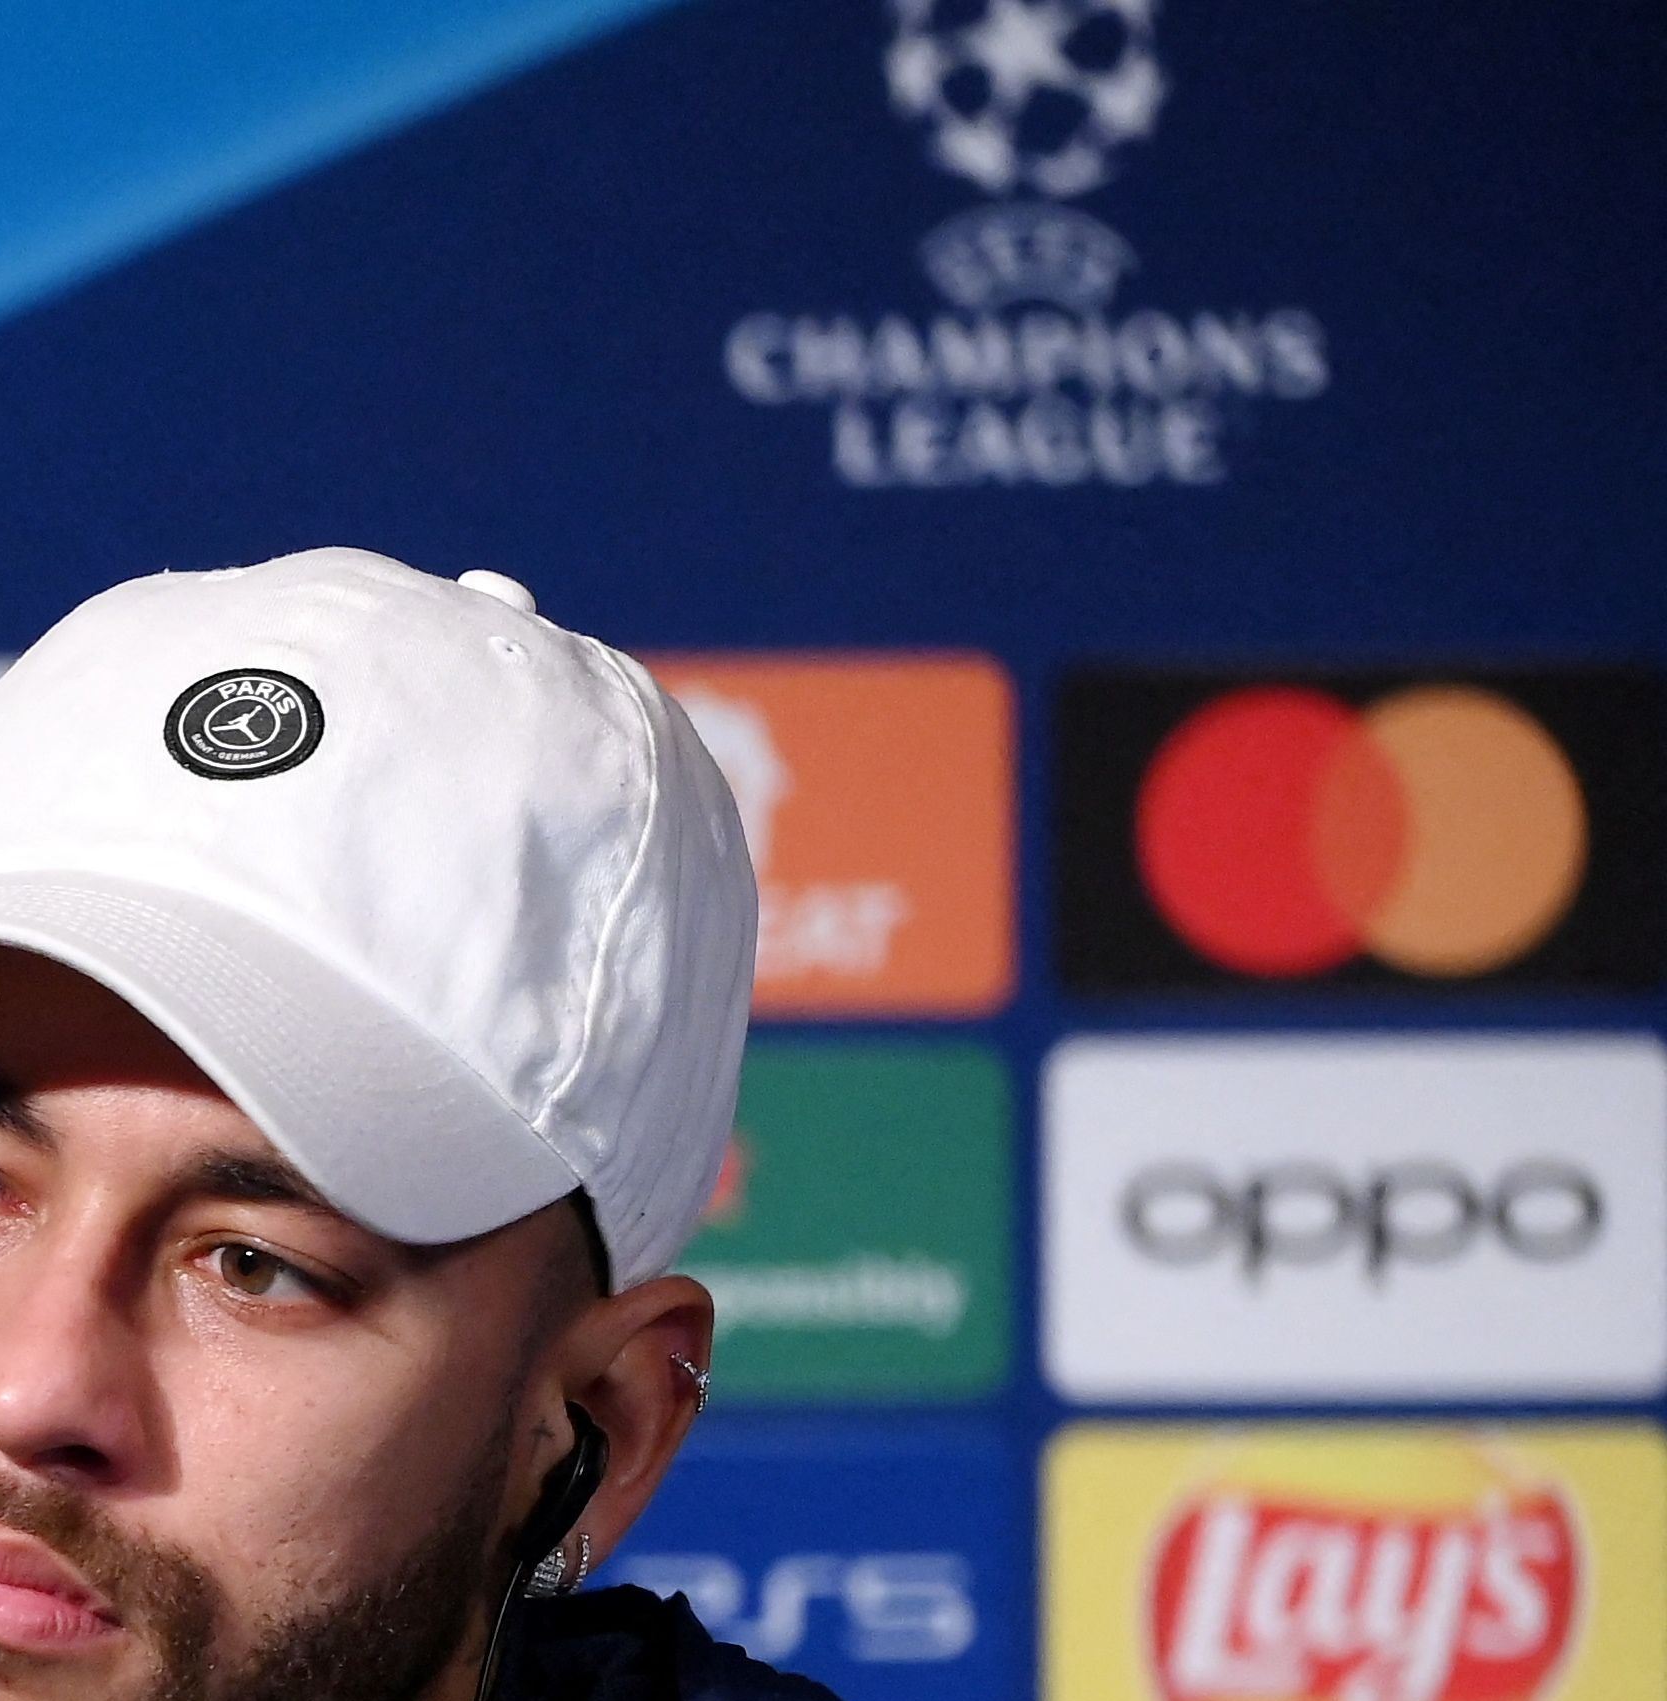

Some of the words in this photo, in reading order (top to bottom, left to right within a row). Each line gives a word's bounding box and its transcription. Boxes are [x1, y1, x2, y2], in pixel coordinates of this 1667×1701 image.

[724, 312, 1327, 402] CHAMPIONS
[833, 402, 1223, 486] LEAGUE
[217, 680, 296, 715] PARIS
[1117, 1154, 1605, 1294] oppo
